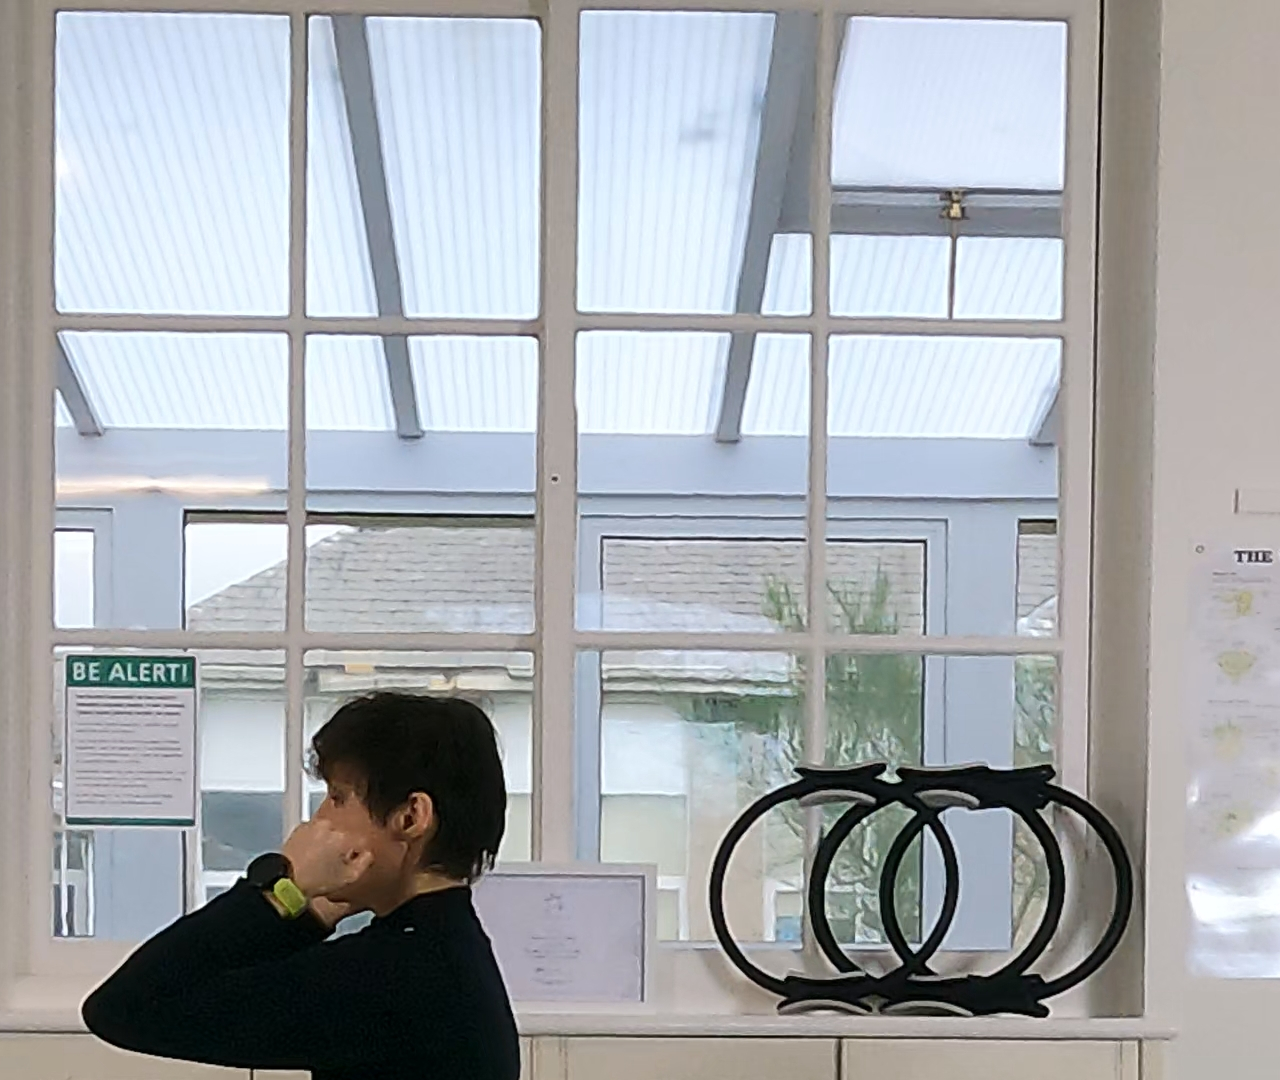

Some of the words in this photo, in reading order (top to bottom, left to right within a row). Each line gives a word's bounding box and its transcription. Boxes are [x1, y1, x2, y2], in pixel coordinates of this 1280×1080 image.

[1234, 550, 1273, 564] THE
[72, 661, 101, 681] BE
[108, 662, 189, 683] ALERT!
